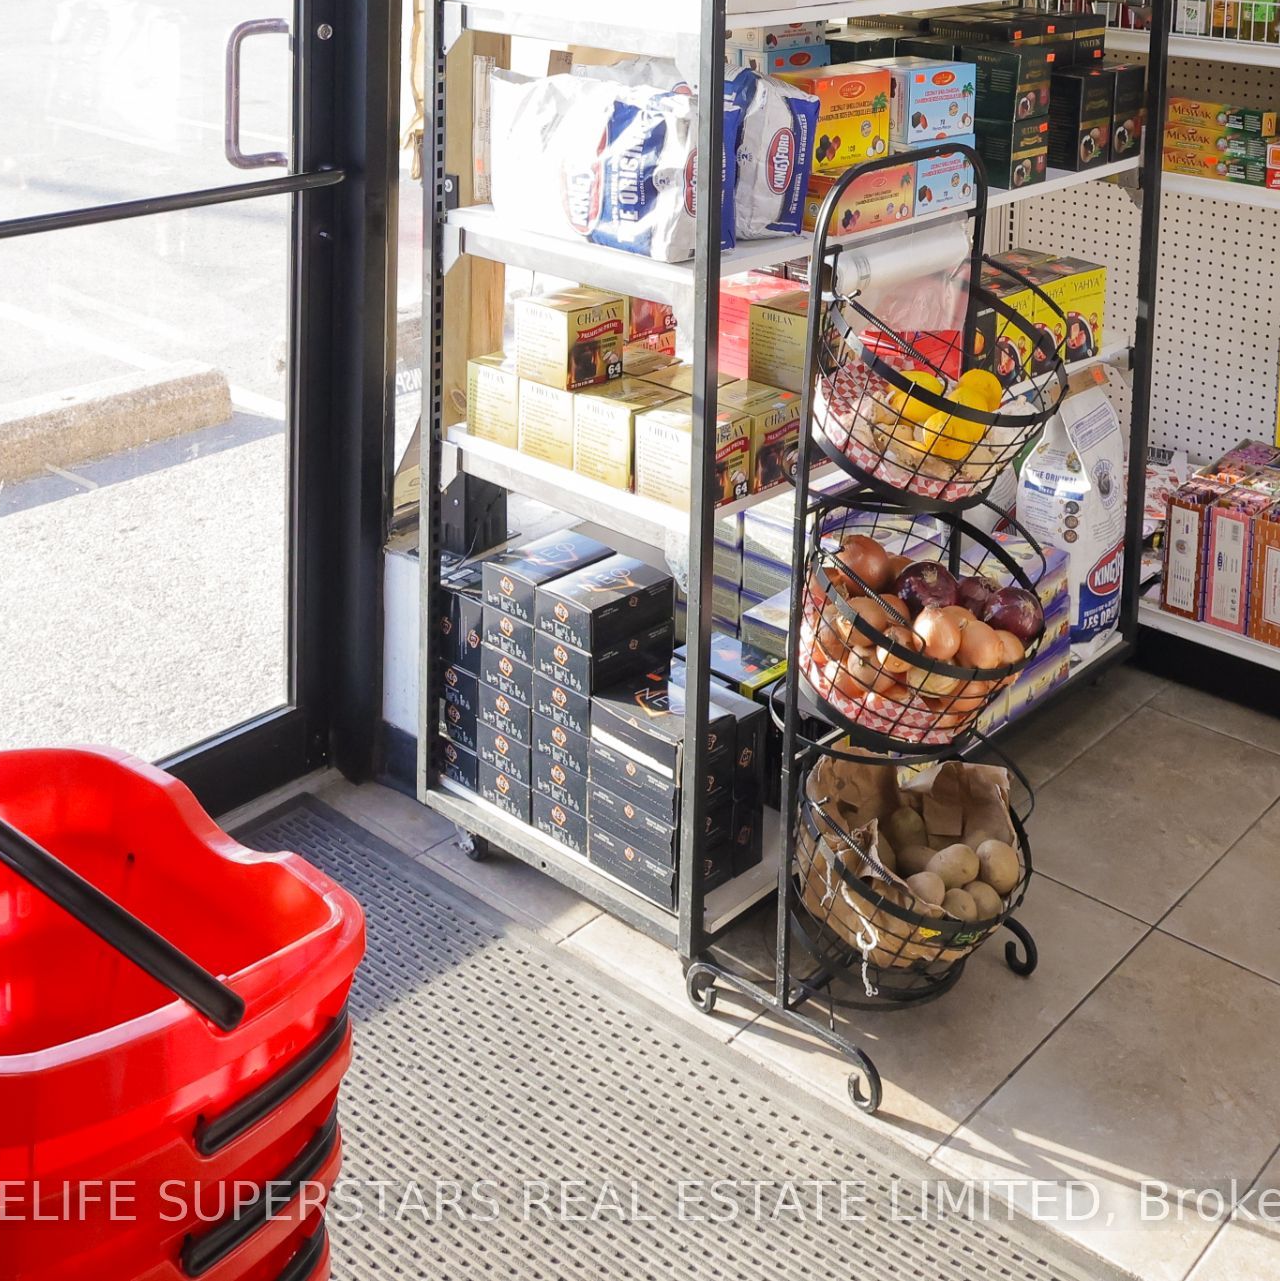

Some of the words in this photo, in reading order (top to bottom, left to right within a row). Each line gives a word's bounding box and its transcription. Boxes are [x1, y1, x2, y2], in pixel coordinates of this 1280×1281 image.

[1171, 104, 1212, 120] MESWAK
[1166, 129, 1210, 144] MESWAK
[773, 133, 792, 190] KINGSFORD
[1072, 277, 1100, 291] YAHYA
[664, 315, 677, 327] 64
[607, 363, 622, 375] 64
[735, 482, 749, 496] 64
